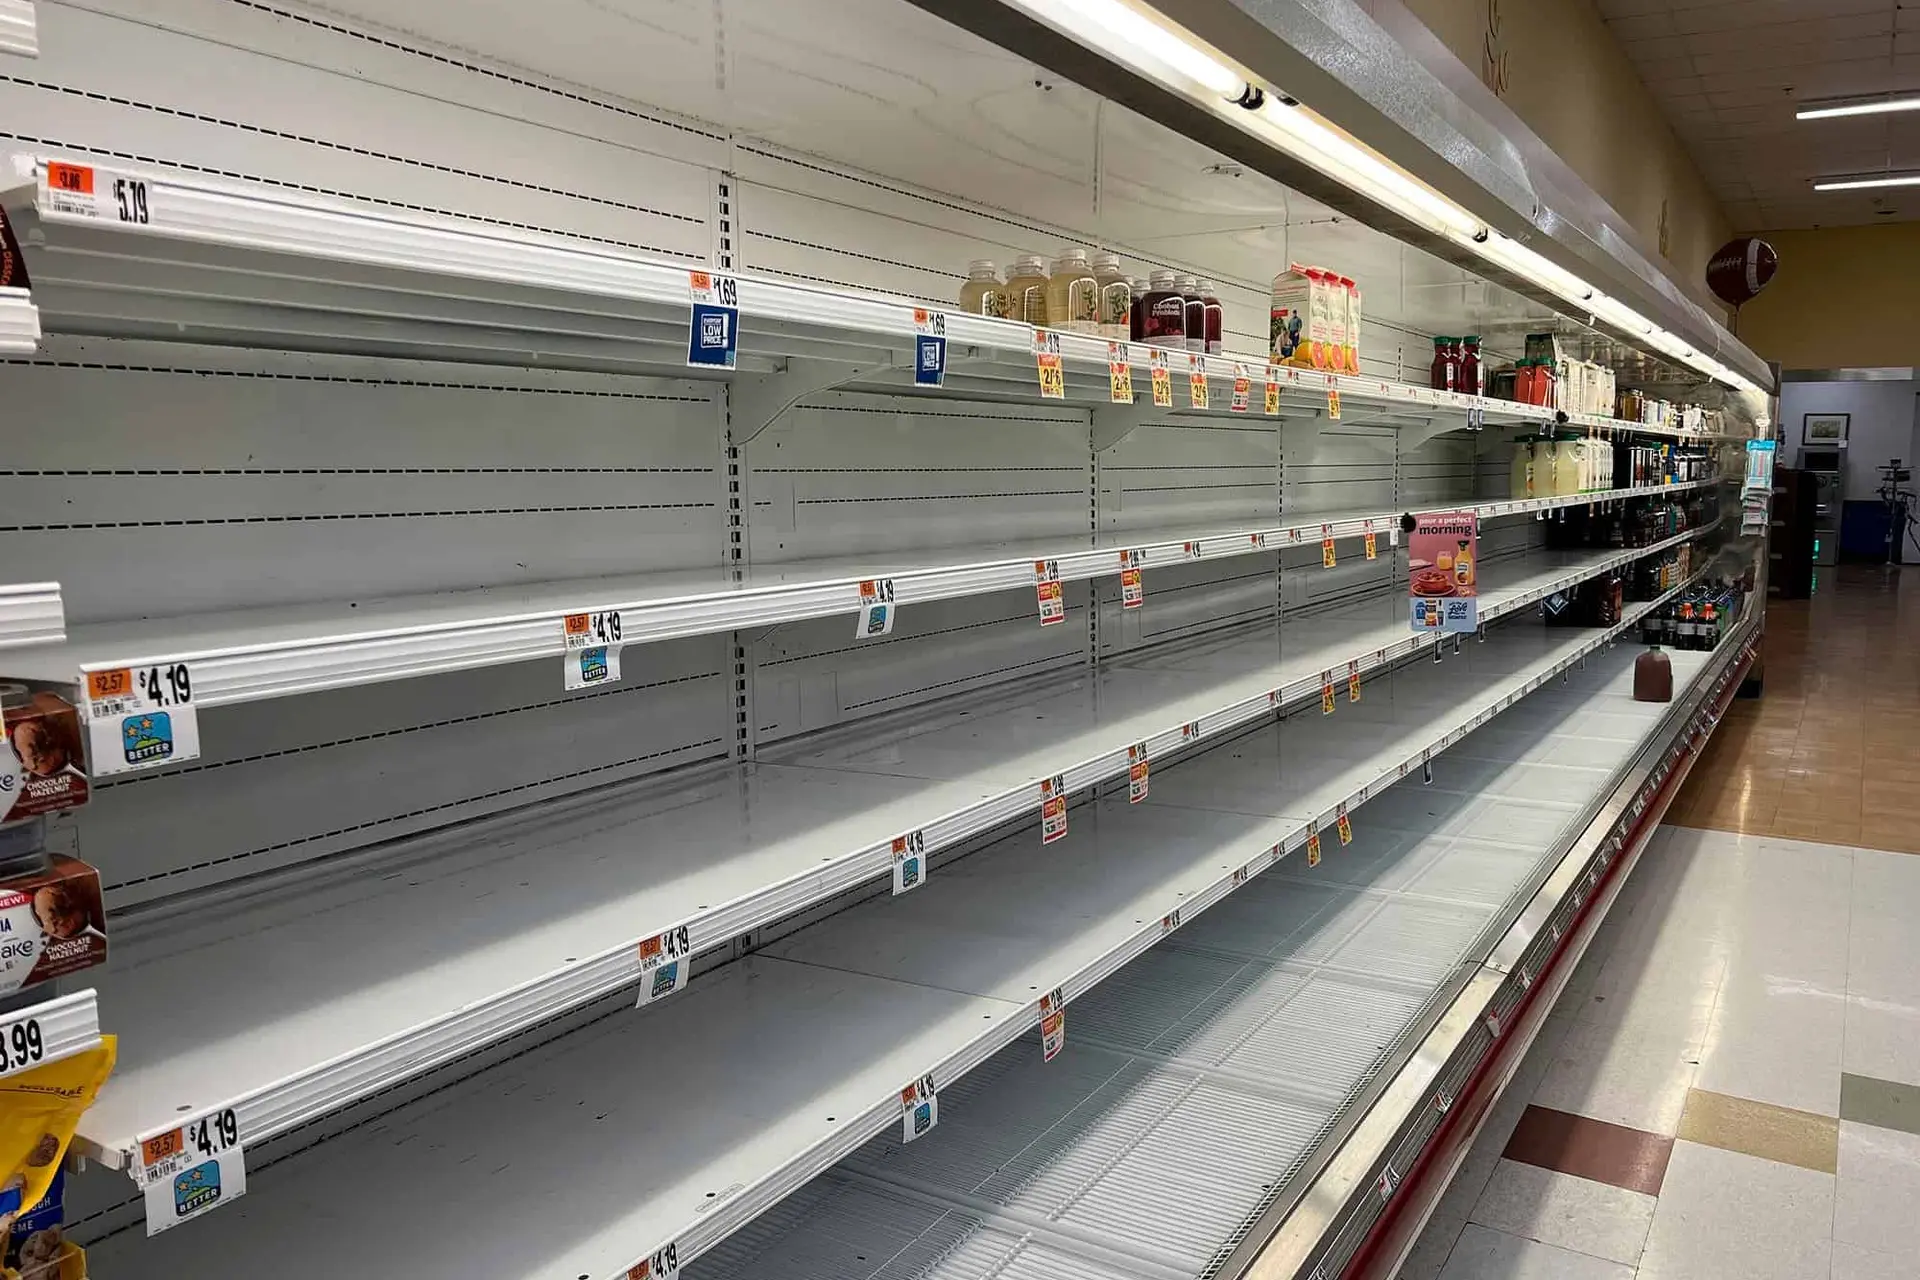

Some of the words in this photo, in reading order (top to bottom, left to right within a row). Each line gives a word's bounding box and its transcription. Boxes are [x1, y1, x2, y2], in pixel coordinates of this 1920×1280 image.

[113, 178, 149, 224] $5.79
[713, 277, 738, 306] $1.69
[703, 325, 722, 336] LOW
[1444, 516, 1472, 525] perfect
[1419, 525, 1472, 537] morning
[592, 611, 622, 643] $4.19
[96, 673, 124, 692] $2.57
[140, 663, 191, 707] $4.19
[128, 742, 170, 761] BETTER
[26, 774, 73, 791] CHOCOLATE
[30, 783, 71, 799] HAZELNUT
[45, 936, 92, 955] CHOCOLATE
[664, 925, 690, 959] $4.19
[49, 945, 90, 962] HAZELNUT
[189, 1108, 238, 1157] $4.19
[149, 1134, 176, 1156] $2.57
[179, 1188, 219, 1214] BETTER
[652, 1242, 678, 1278] $4.19
